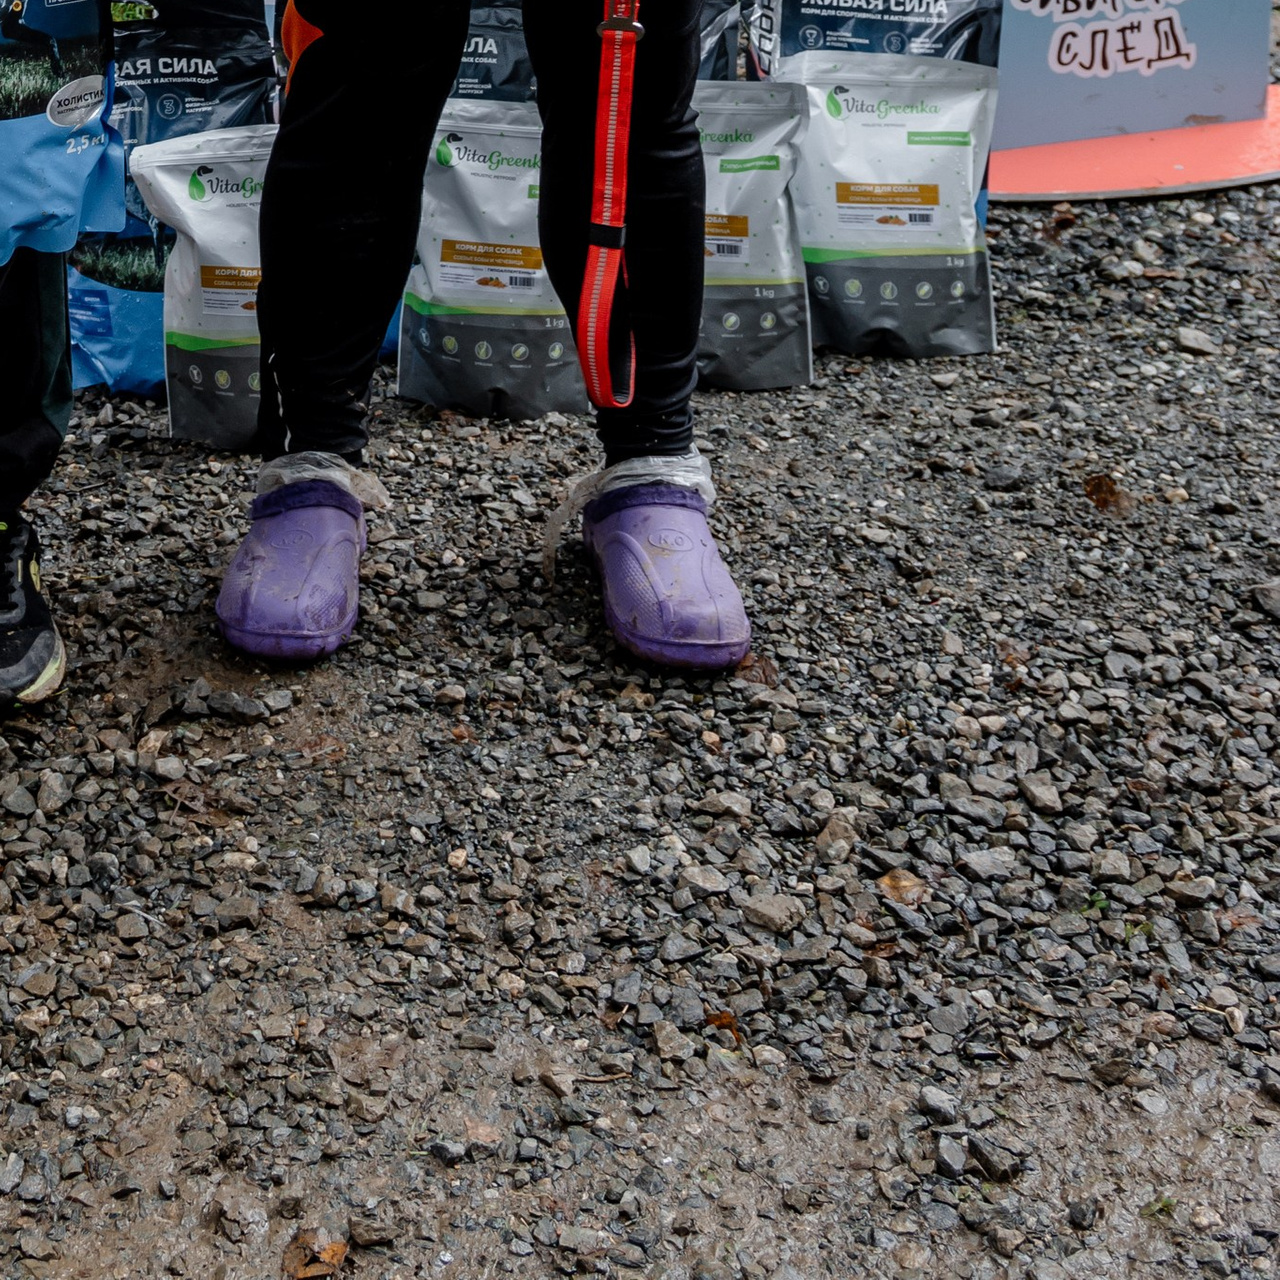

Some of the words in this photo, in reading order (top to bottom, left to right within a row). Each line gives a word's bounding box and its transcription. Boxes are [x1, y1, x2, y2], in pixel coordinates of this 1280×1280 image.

[801, 7, 821, 15] КОРМ
[821, 9, 836, 17] ДЛЯ
[836, 10, 882, 20] СПОРТИВНЫХ
[463, 37, 498, 54] ЛА
[1057, 17, 1195, 71] СЛЁД
[158, 57, 218, 75] СИЛА
[163, 99, 175, 114] 3
[843, 97, 940, 119] VitaGreenka
[66, 134, 90, 155] 2,5
[699, 128, 755, 145] Greenka
[455, 146, 541, 171] VitaGreenk
[207, 177, 263, 198] VitaGr
[455, 244, 477, 252] КОРМ
[477, 245, 494, 253] ДЛЯ
[495, 246, 523, 255] СОБАК
[953, 257, 964, 267] kg
[239, 268, 258, 278] ДЛЯ
[755, 287, 761, 297] 1
[762, 288, 775, 299] kg
[545, 318, 551, 327] 1
[552, 318, 564, 328] kg
